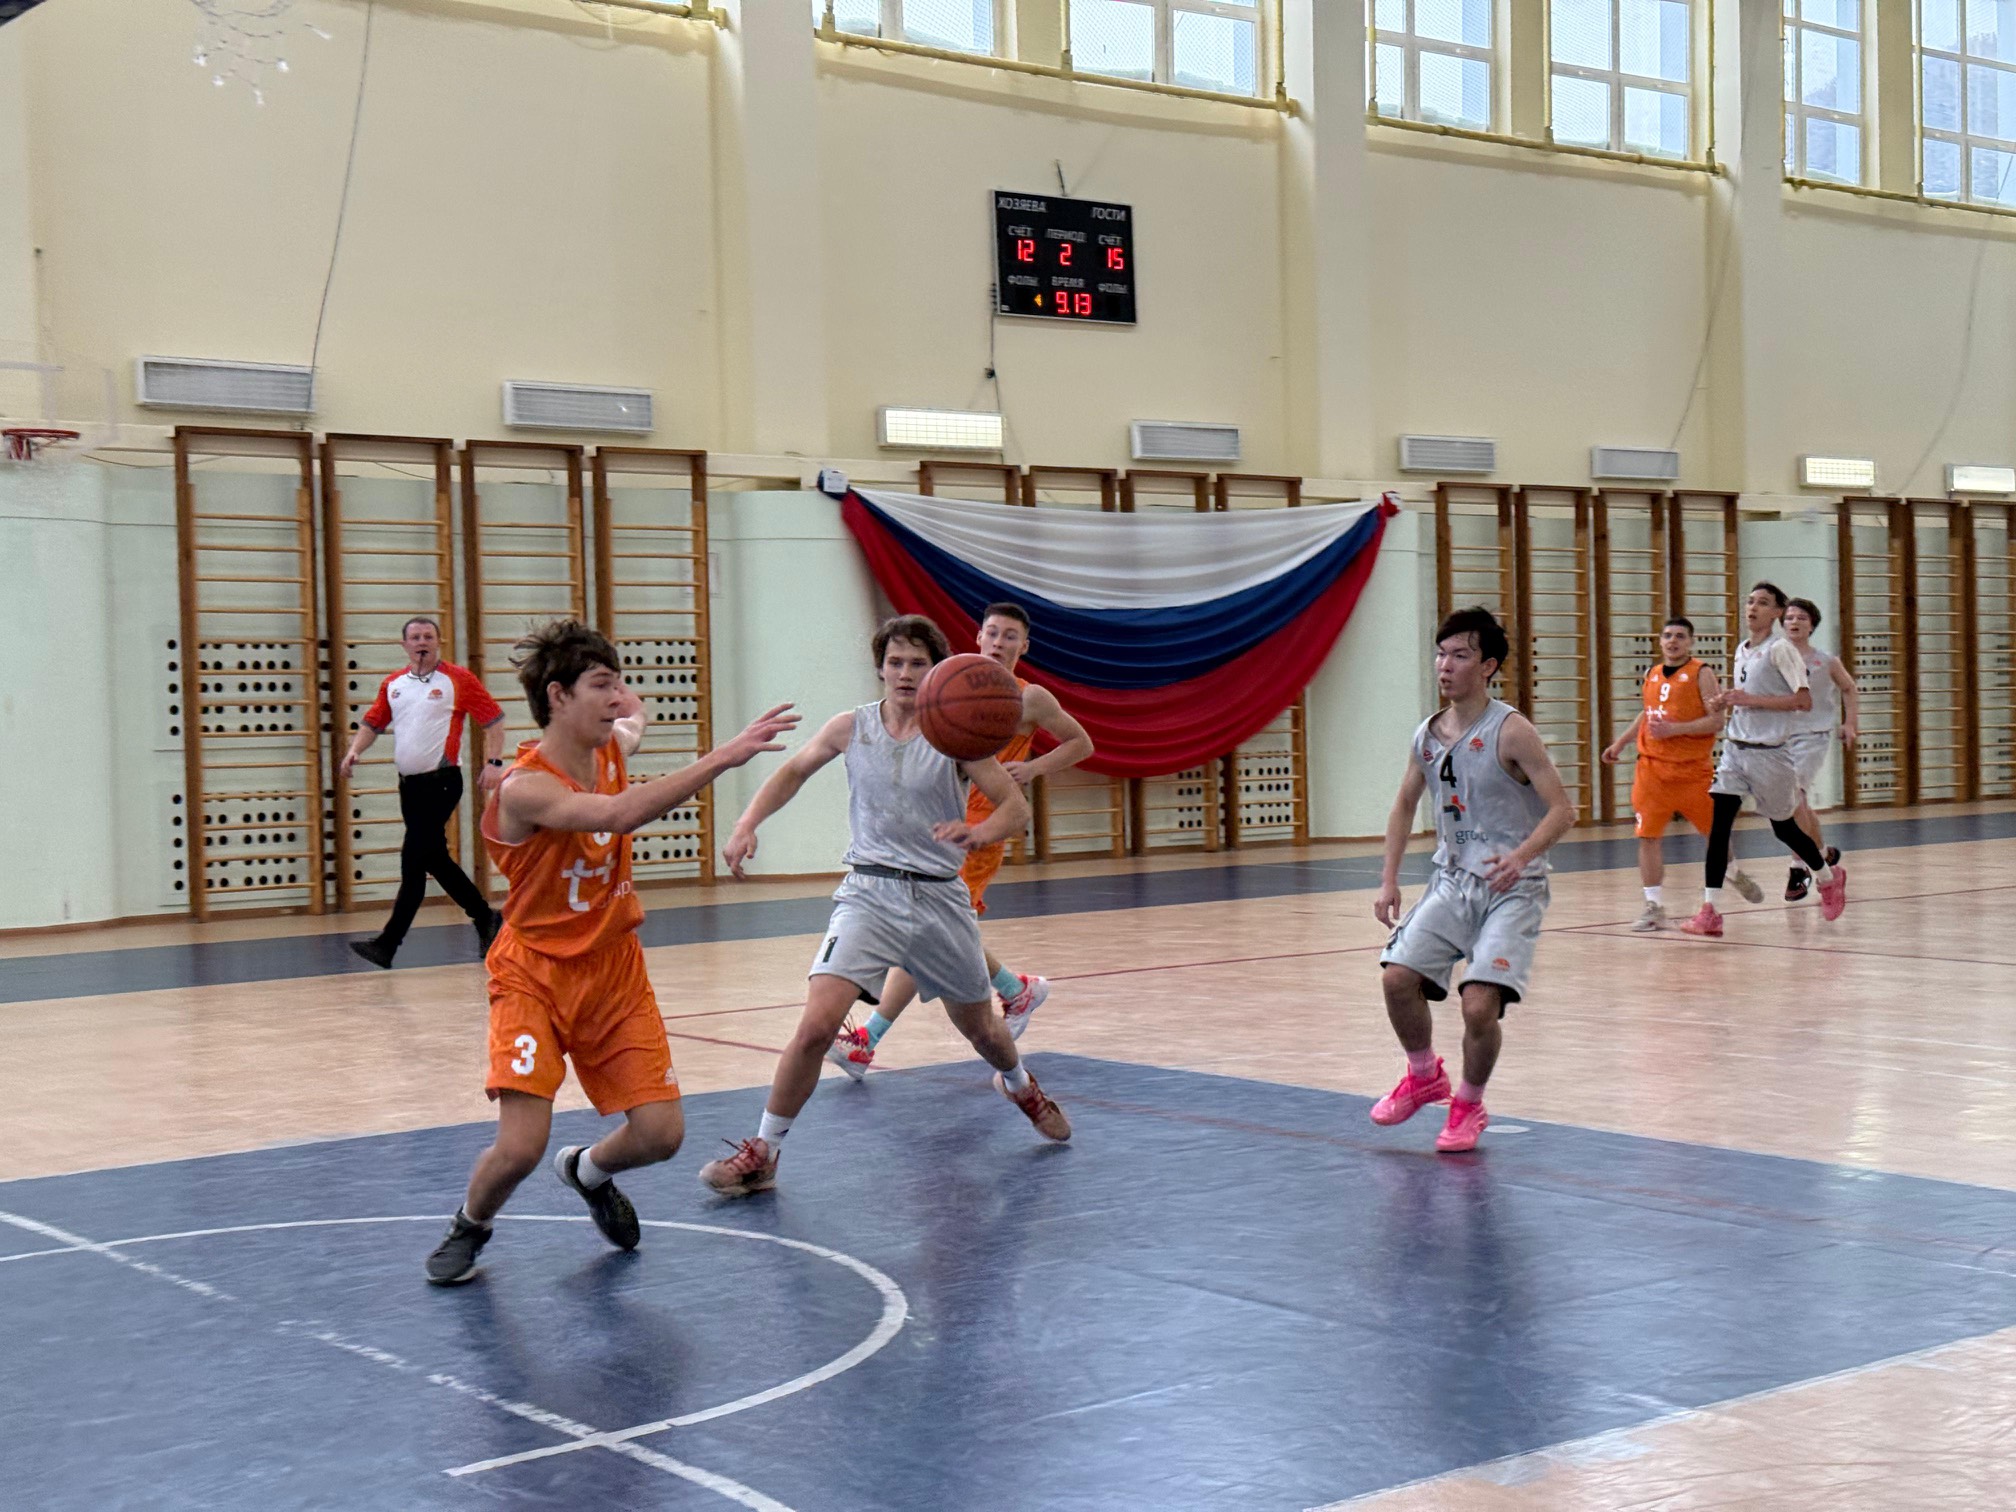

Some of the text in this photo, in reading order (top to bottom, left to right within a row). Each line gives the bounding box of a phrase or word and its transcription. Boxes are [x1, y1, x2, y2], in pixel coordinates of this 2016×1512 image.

[1091, 207, 1127, 221] ГОСТИ
[1018, 240, 1035, 262] 12
[1060, 243, 1072, 266] 2
[1107, 248, 1124, 270] 15
[1660, 682, 1671, 702] 9
[1440, 755, 1457, 788] 4
[822, 936, 838, 963] 1
[511, 1034, 538, 1075] 3
